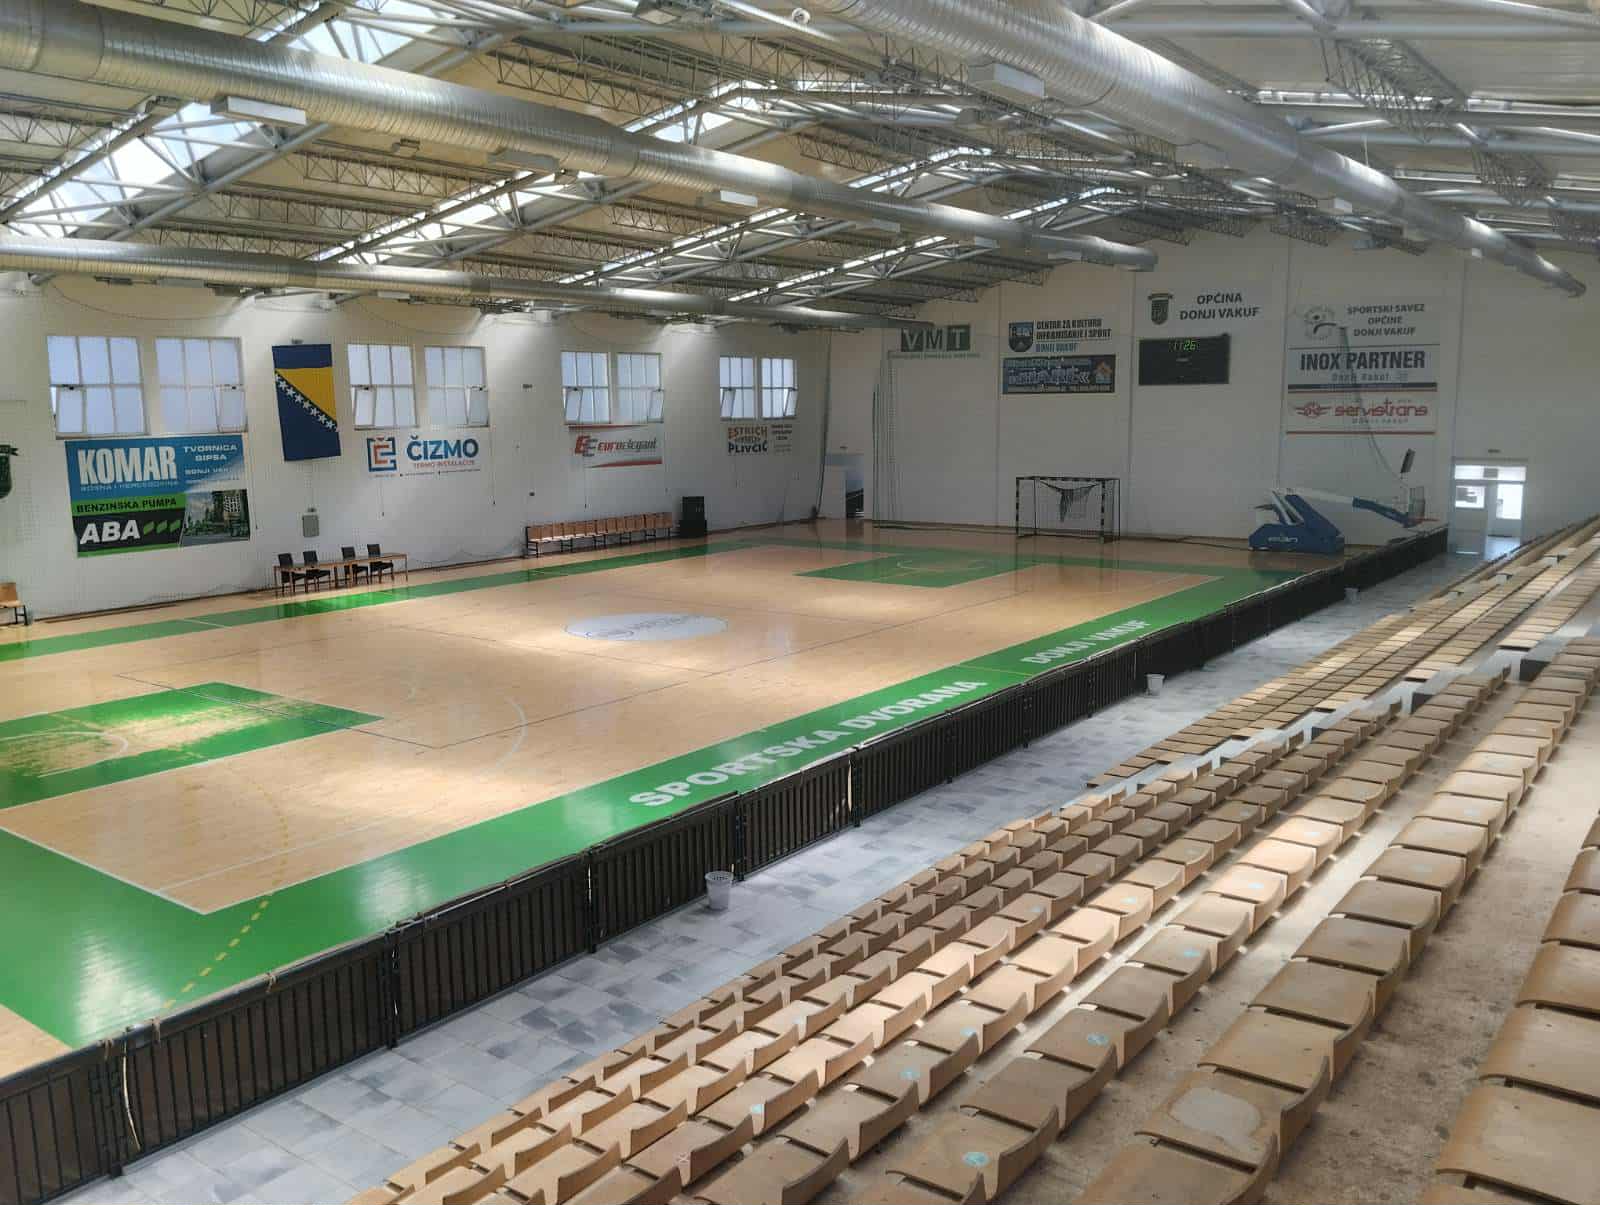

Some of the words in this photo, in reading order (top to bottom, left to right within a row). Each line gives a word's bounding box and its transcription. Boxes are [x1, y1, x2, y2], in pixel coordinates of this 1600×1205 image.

[1180, 310, 1216, 320] DONJI
[1219, 307, 1260, 318] VAKUF
[1395, 304, 1425, 312] SAVEZ
[901, 326, 970, 352] VMT
[1300, 353, 1340, 370] INOX
[1347, 351, 1425, 369] PARTNER
[184, 444, 237, 453] TVORNICA
[407, 435, 479, 460] ČIZMO
[78, 446, 177, 485] KOMAR
[77, 501, 139, 513] BENZINSKA
[142, 497, 177, 509] PUMPA
[80, 519, 140, 544] ABA
[629, 729, 852, 806] SPORTSKA
[841, 680, 988, 730] DVORANA
